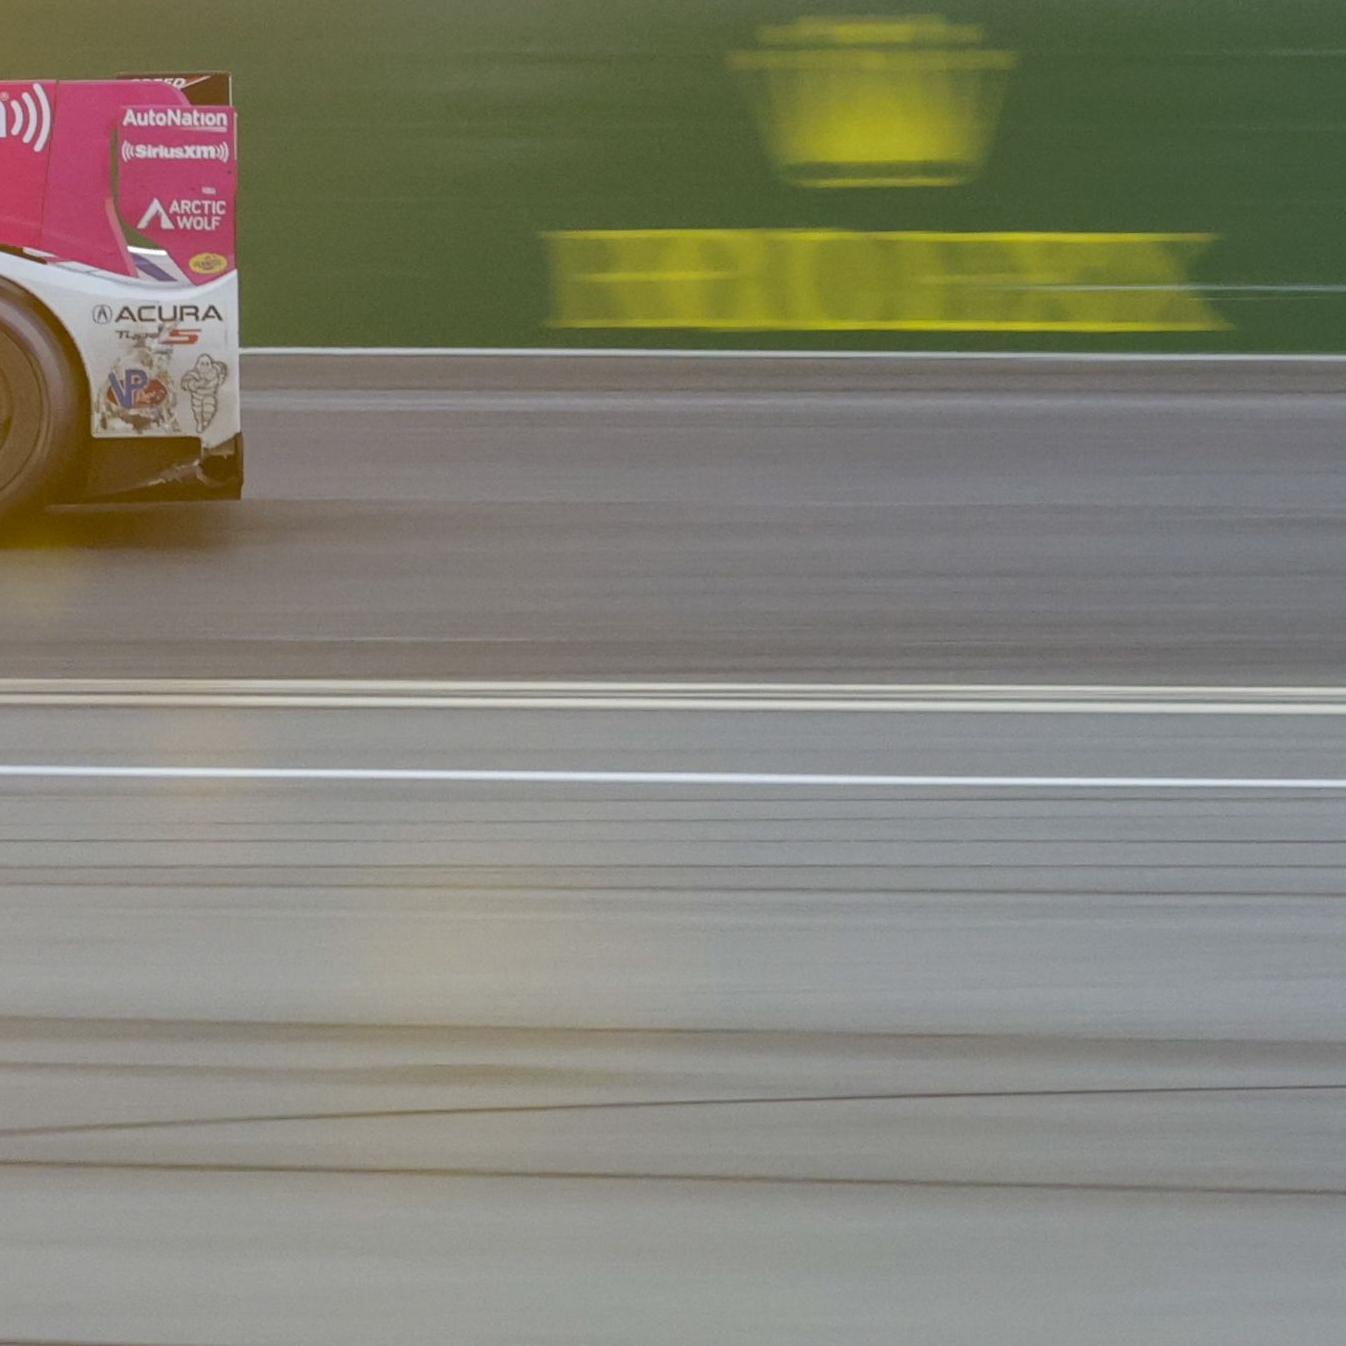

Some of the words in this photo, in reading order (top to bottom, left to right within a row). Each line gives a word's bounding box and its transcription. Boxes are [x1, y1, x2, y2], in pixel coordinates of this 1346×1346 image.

[122, 109, 228, 126] AutoNation
[169, 200, 226, 215] ARCTIC
[177, 216, 221, 231] WOLF
[115, 305, 223, 323] ACURA
